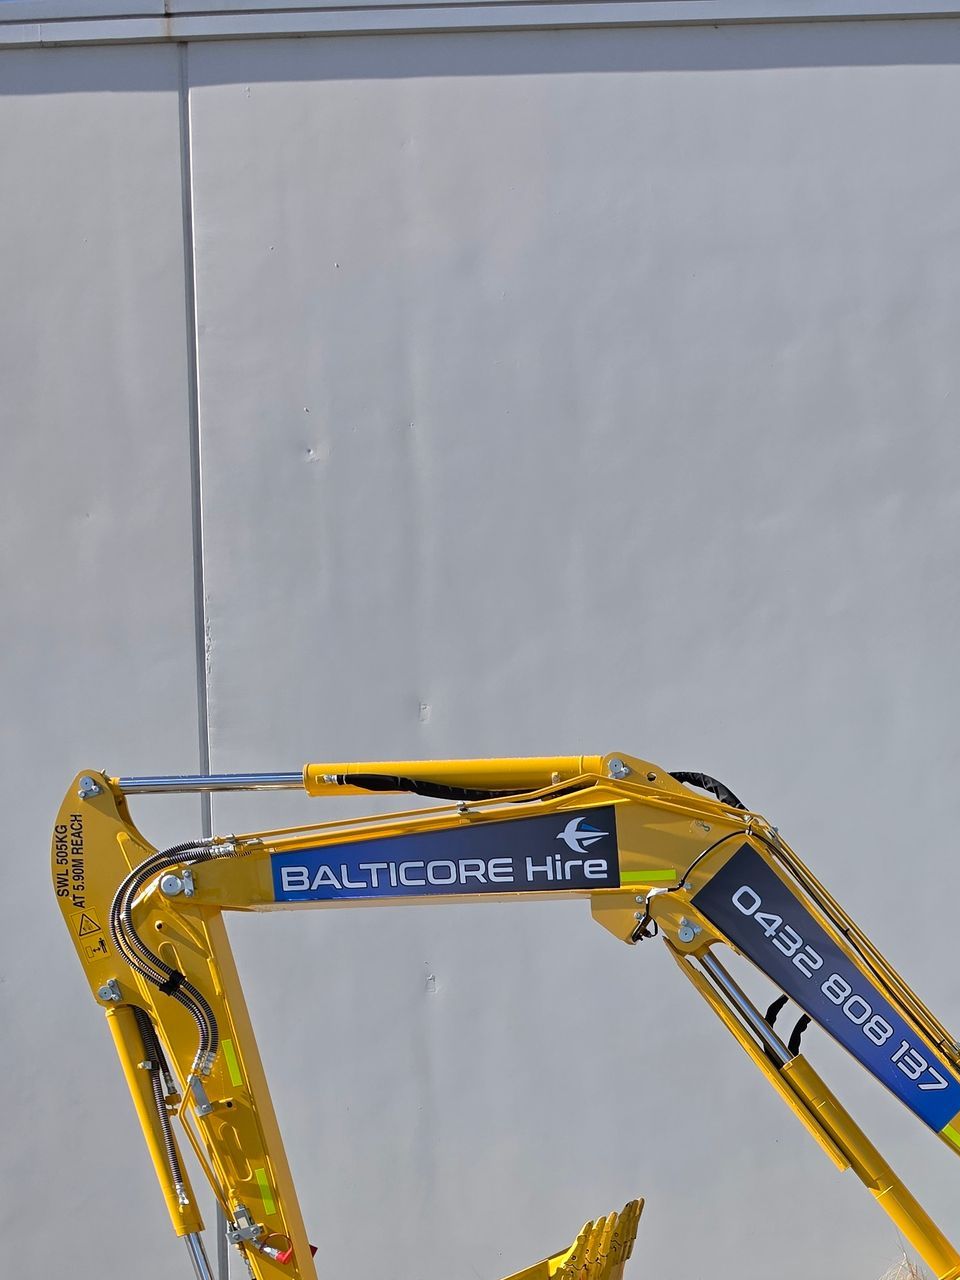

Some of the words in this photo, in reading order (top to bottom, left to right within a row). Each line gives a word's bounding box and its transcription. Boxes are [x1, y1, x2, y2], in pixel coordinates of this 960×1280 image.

[55, 824, 68, 865] 505KG
[70, 814, 83, 855] REACH
[57, 869, 69, 897] SWL
[71, 859, 84, 891] 5.90M
[280, 857, 514, 892] BALTICORE
[525, 853, 608, 882] Hire
[73, 894, 85, 909] AT
[731, 885, 824, 979] 0432
[820, 973, 895, 1047] 808
[890, 1040, 949, 1091] 137
